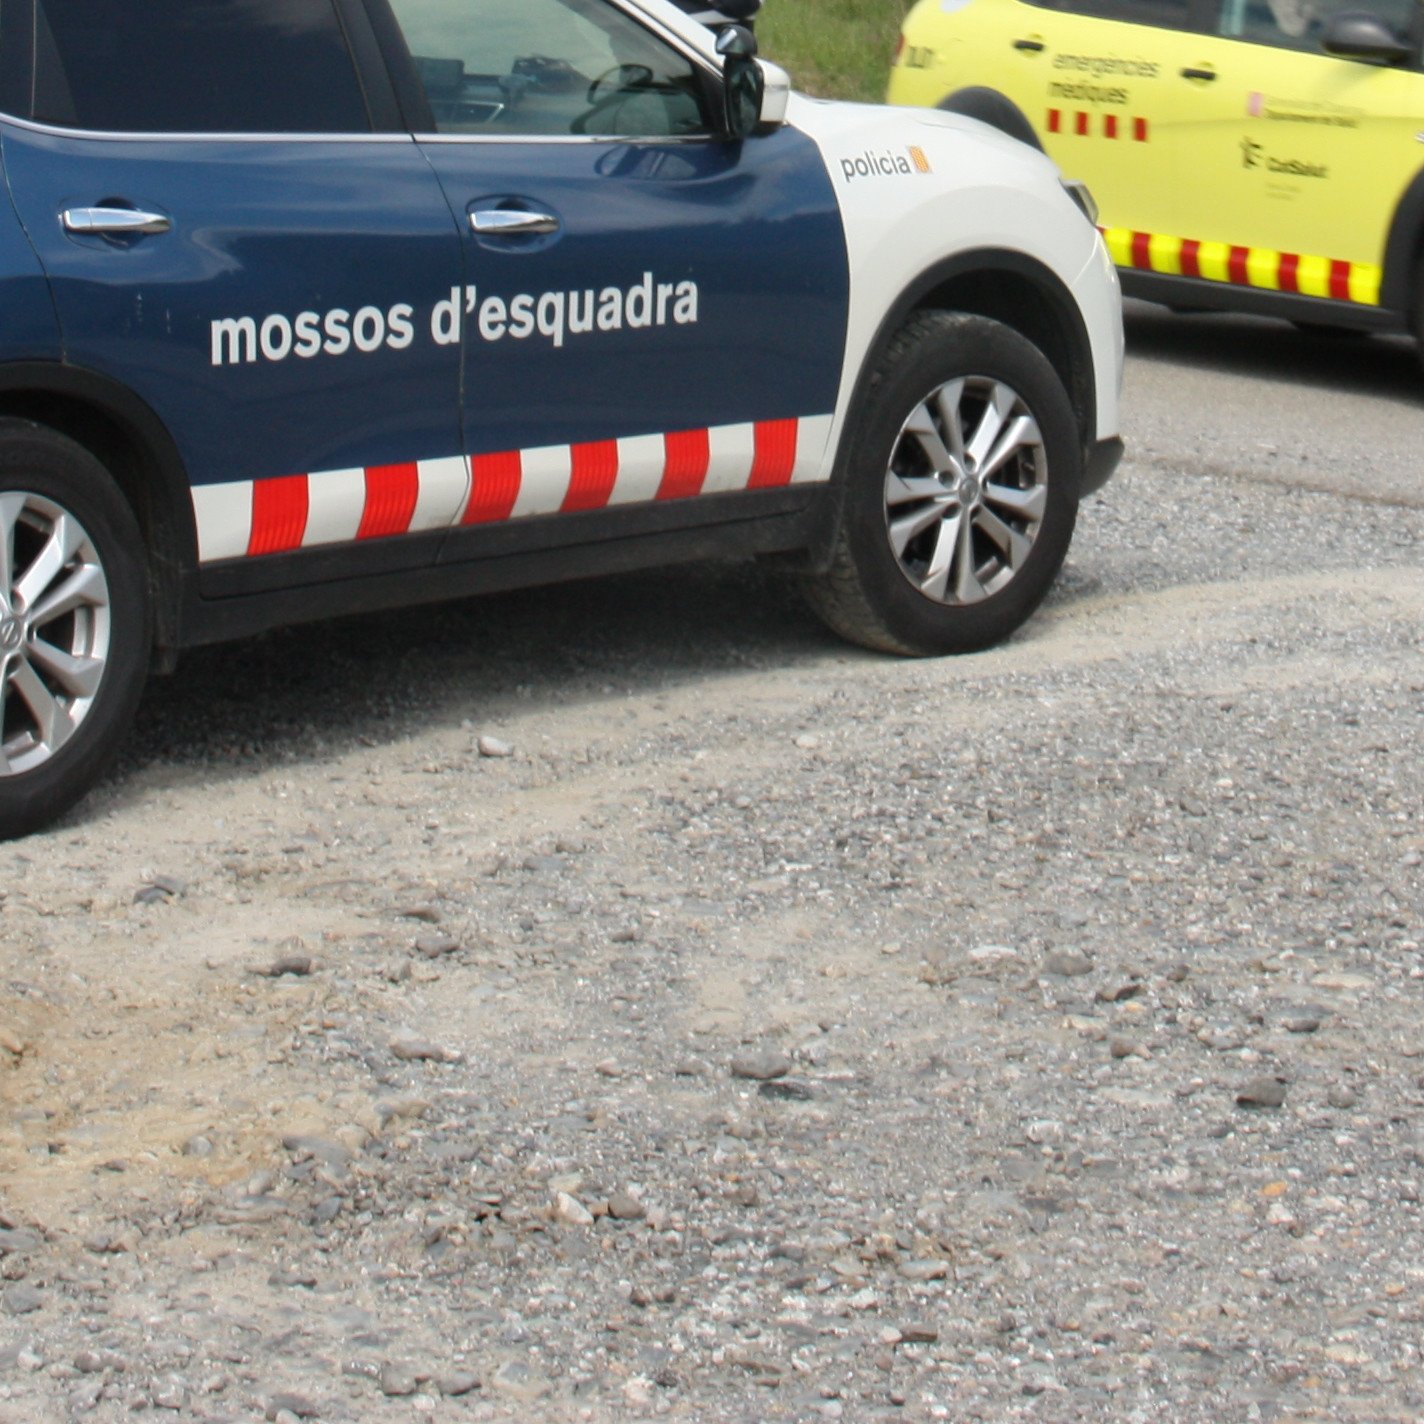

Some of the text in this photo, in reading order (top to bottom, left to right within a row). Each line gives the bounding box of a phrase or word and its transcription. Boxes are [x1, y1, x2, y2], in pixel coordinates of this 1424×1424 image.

[840, 149, 911, 183] policia
[210, 271, 698, 366] mossos d'esquadra
